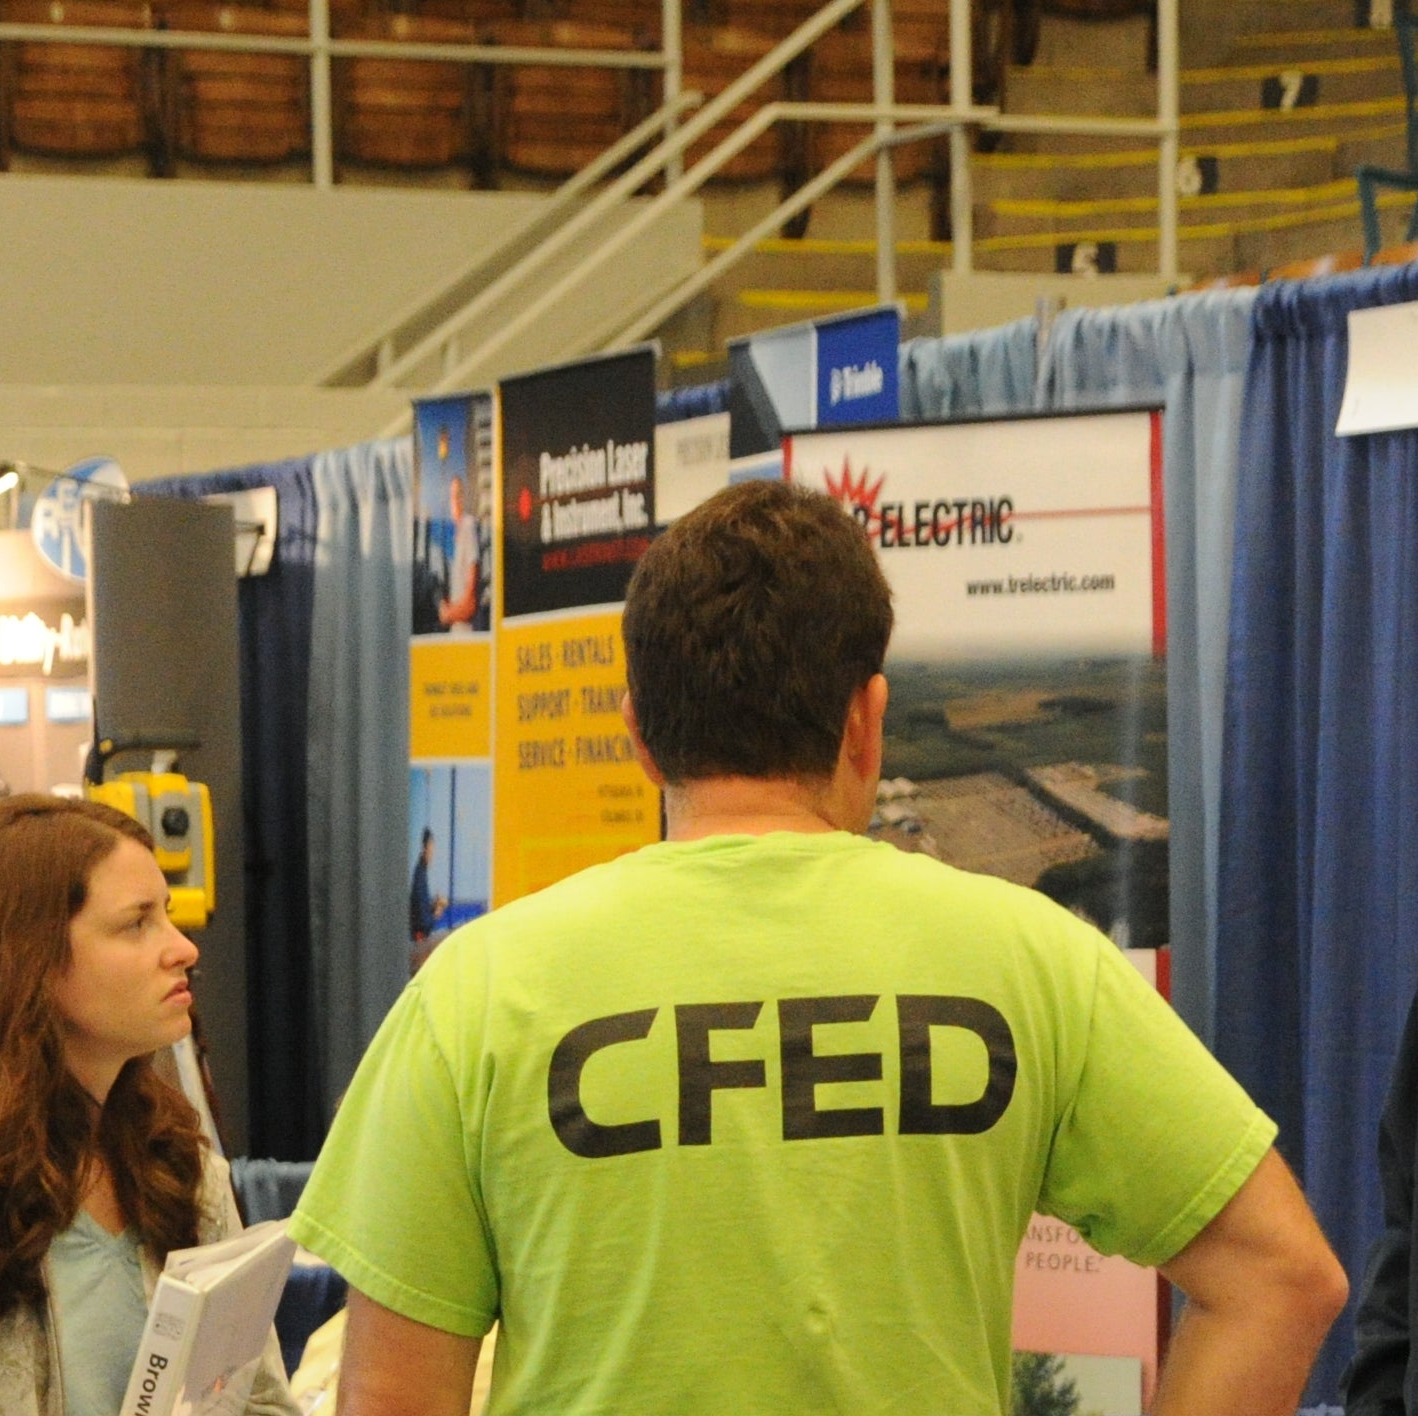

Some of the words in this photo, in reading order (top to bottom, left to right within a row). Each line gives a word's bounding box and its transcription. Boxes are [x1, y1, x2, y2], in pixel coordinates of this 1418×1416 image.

[539, 443, 606, 499] Precision
[607, 438, 649, 487] Laser
[880, 495, 1015, 549] ELECTRIC
[966, 571, 1116, 597] www.trelectric.com
[517, 642, 553, 676] SALES
[561, 634, 615, 669] RENTALS
[518, 688, 571, 724] SUPPORT
[518, 737, 567, 771] SERVICE
[547, 994, 1018, 1159] CFED
